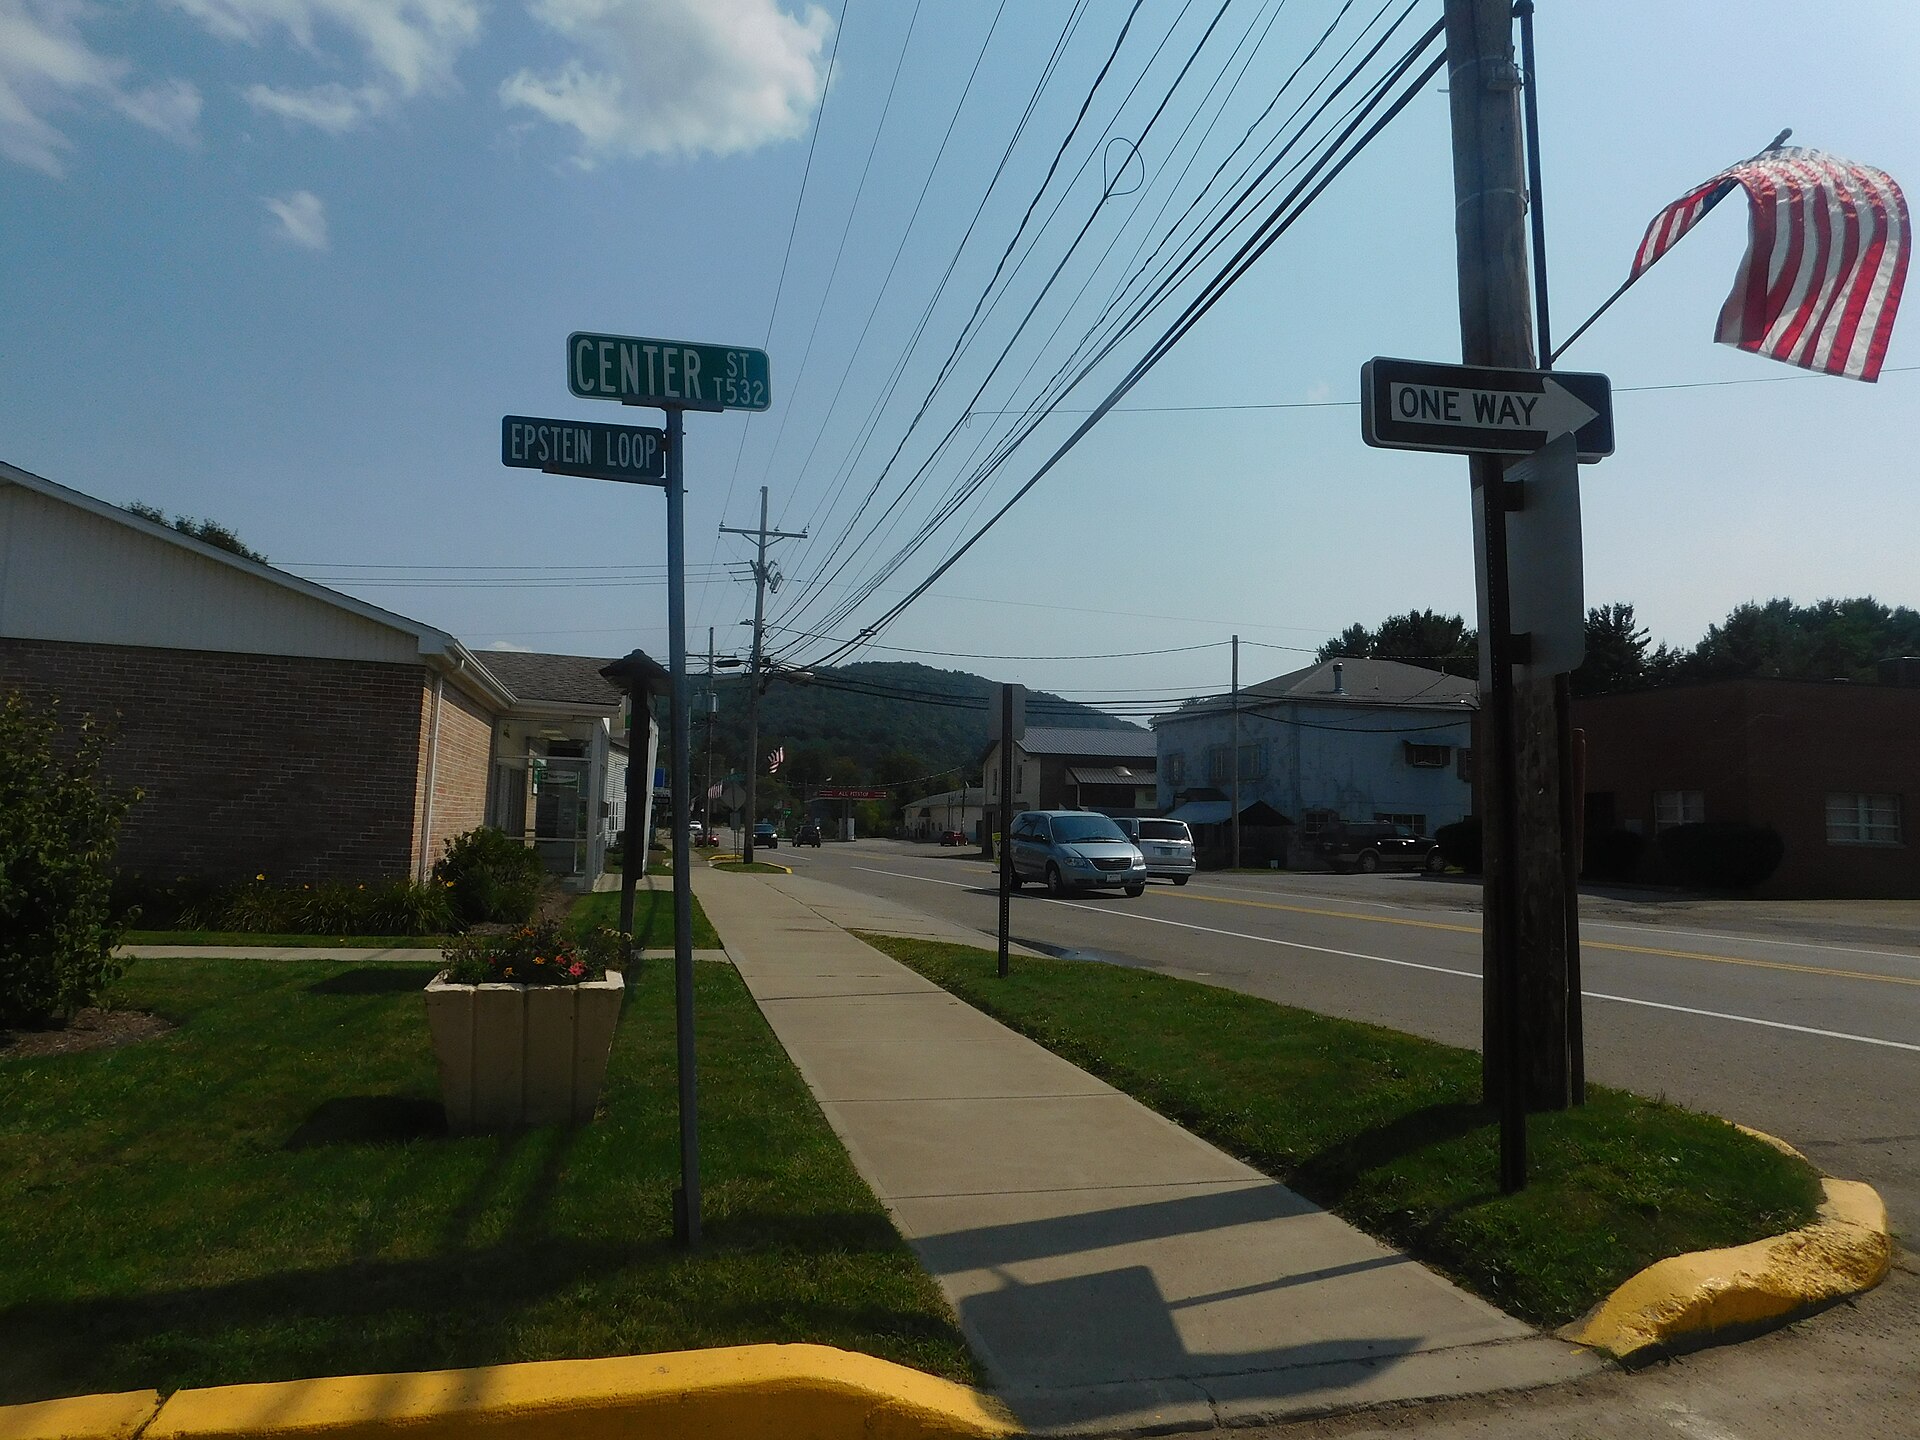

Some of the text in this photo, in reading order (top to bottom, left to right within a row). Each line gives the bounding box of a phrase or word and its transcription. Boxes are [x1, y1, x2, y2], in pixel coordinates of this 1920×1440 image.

[576, 339, 702, 399] CENTER
[726, 351, 750, 378] ST
[712, 376, 765, 406] T532
[1398, 387, 1539, 426] ONE WAY
[511, 423, 657, 469] EPSTEIN LOOP
